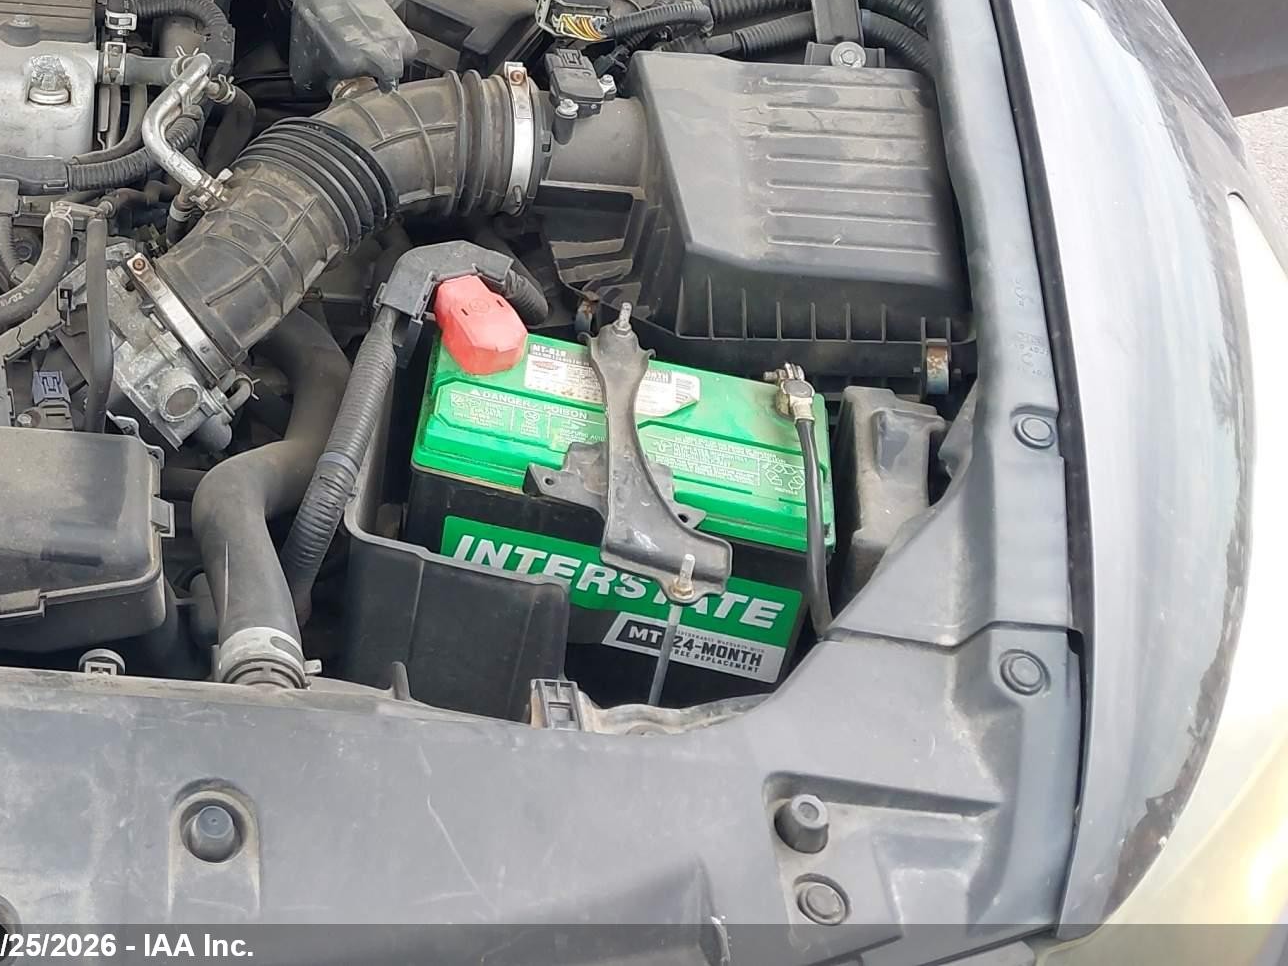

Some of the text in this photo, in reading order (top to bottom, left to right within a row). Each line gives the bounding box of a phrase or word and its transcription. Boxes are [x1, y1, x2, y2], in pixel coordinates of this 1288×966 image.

[544, 404, 589, 420] POISON
[628, 625, 662, 645] MT
[672, 636, 763, 667] 24-MONTH
[674, 649, 759, 673] REE REPLACEMENT
